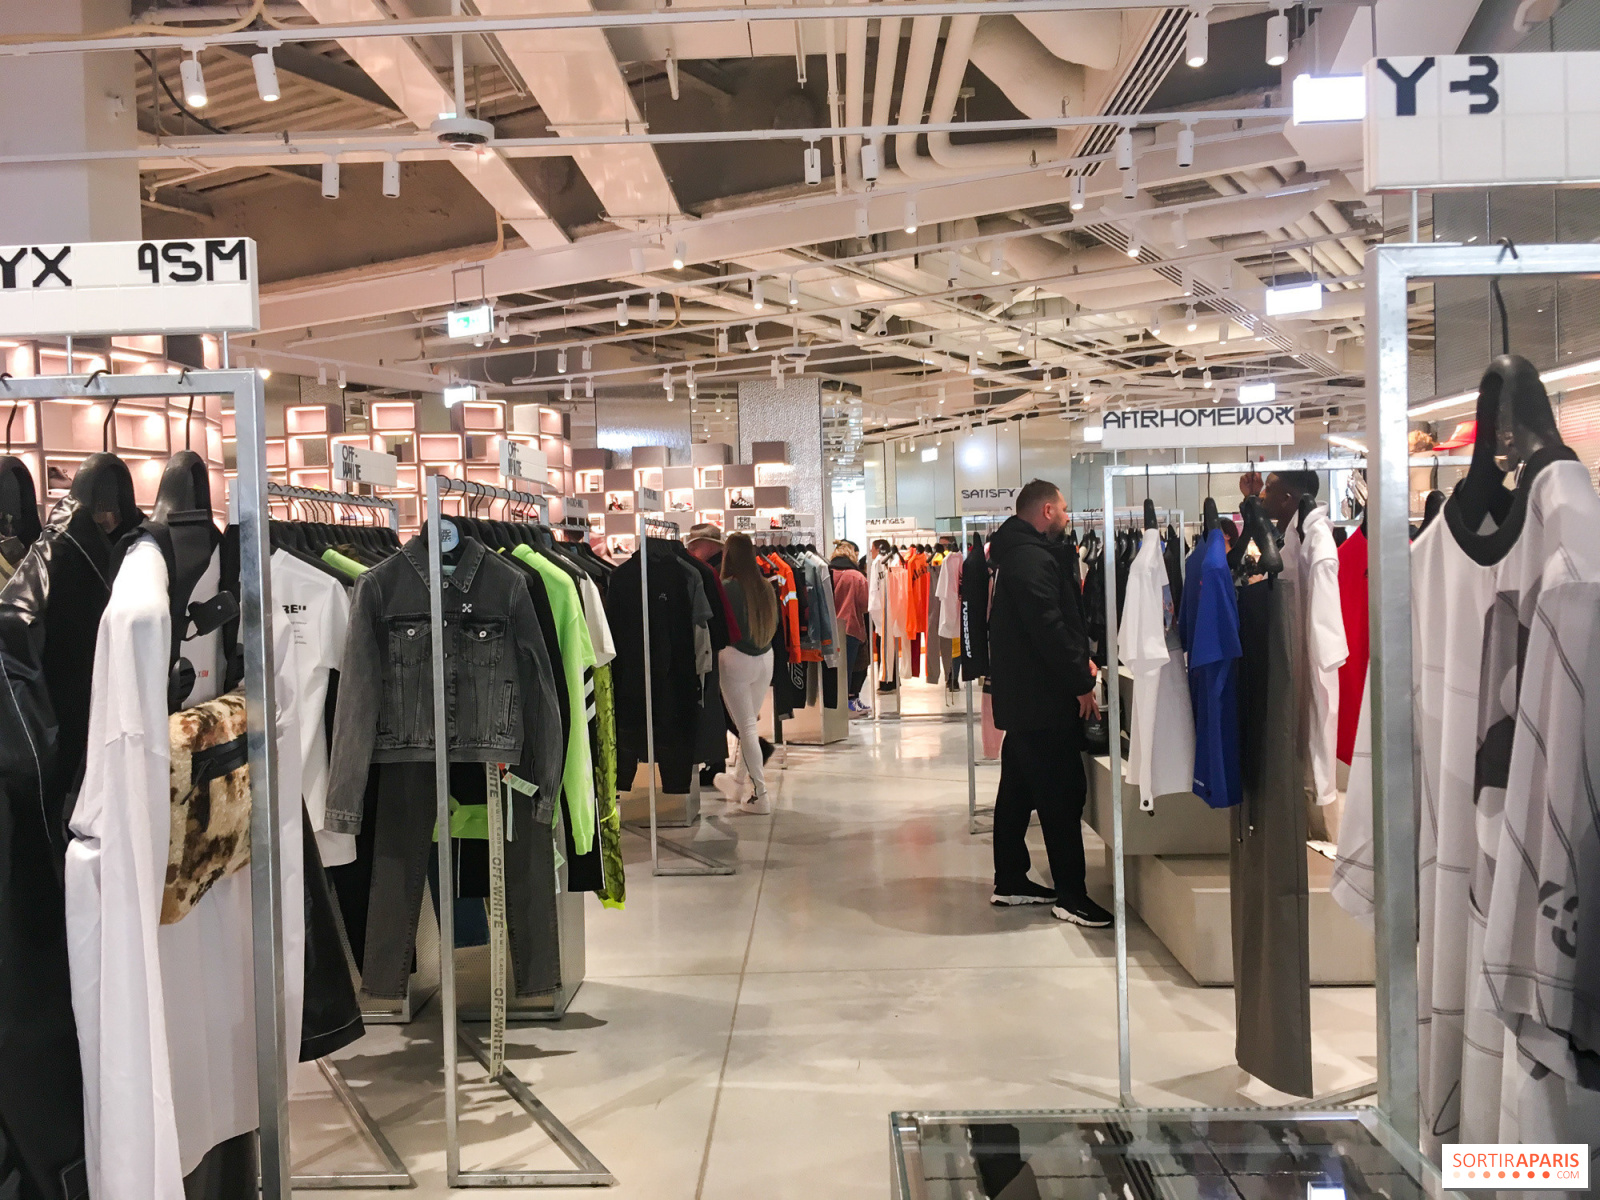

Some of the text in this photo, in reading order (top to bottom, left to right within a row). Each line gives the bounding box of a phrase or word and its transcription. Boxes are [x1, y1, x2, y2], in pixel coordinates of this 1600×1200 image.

[1377, 55, 1499, 116] Y-3
[961, 489, 1016, 499] SATISFY
[488, 763, 499, 798] HITE
